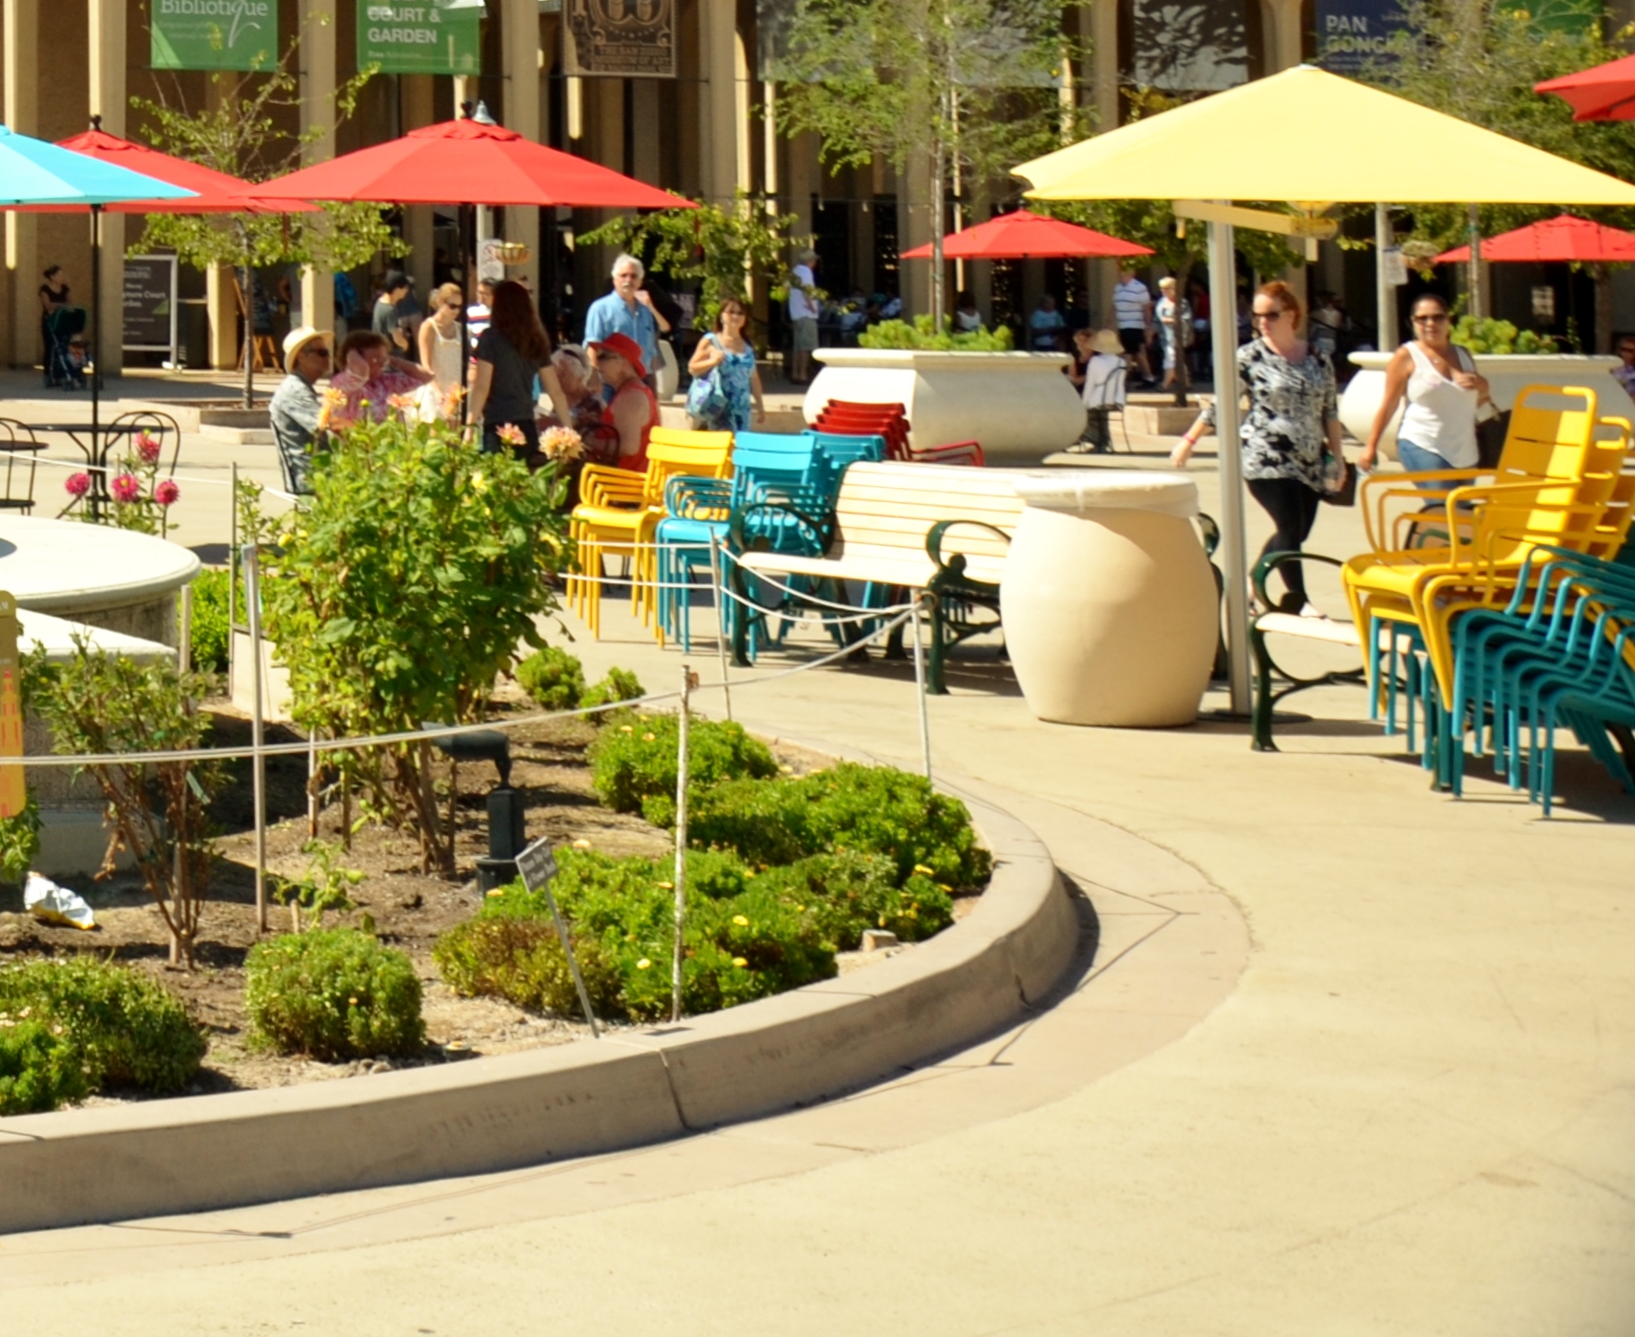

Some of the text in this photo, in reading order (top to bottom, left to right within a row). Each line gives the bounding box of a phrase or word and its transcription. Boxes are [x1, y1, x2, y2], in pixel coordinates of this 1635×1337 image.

[367, 7, 441, 23] COURT &
[1325, 15, 1368, 33] PAN
[367, 27, 438, 44] GARDEN
